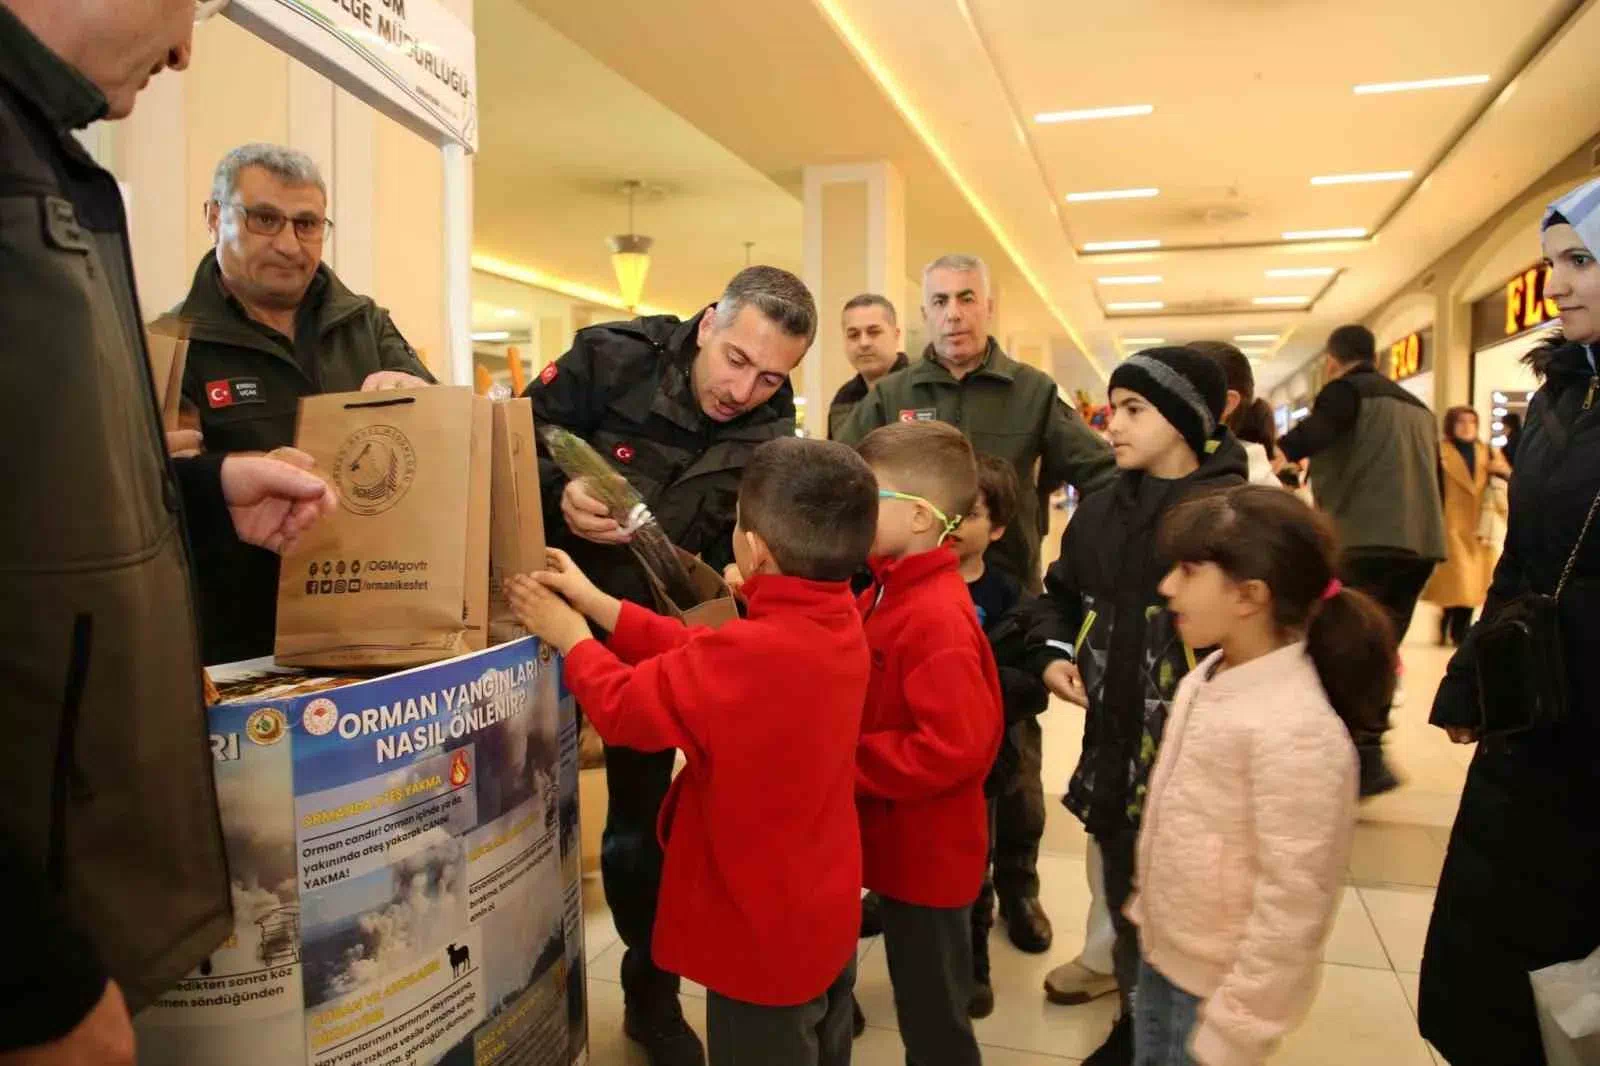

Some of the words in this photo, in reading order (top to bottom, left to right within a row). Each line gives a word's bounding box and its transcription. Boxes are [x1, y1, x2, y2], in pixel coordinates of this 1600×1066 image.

[1389, 332, 1420, 381] FLO
[338, 692, 437, 740] ORMAN
[441, 658, 538, 712] YANGINLARI
[376, 721, 446, 764] NASIL
[303, 840, 344, 859] Orman
[345, 825, 383, 846] candır!
[383, 815, 414, 833] Orman
[303, 849, 361, 877] yakınında
[362, 842, 384, 858] ateş
[385, 828, 421, 850] yakarak
[303, 869, 350, 890] YAKMA!
[191, 985, 285, 1006] söndüğünden
[228, 973, 268, 988] sonra
[270, 966, 294, 980] köz
